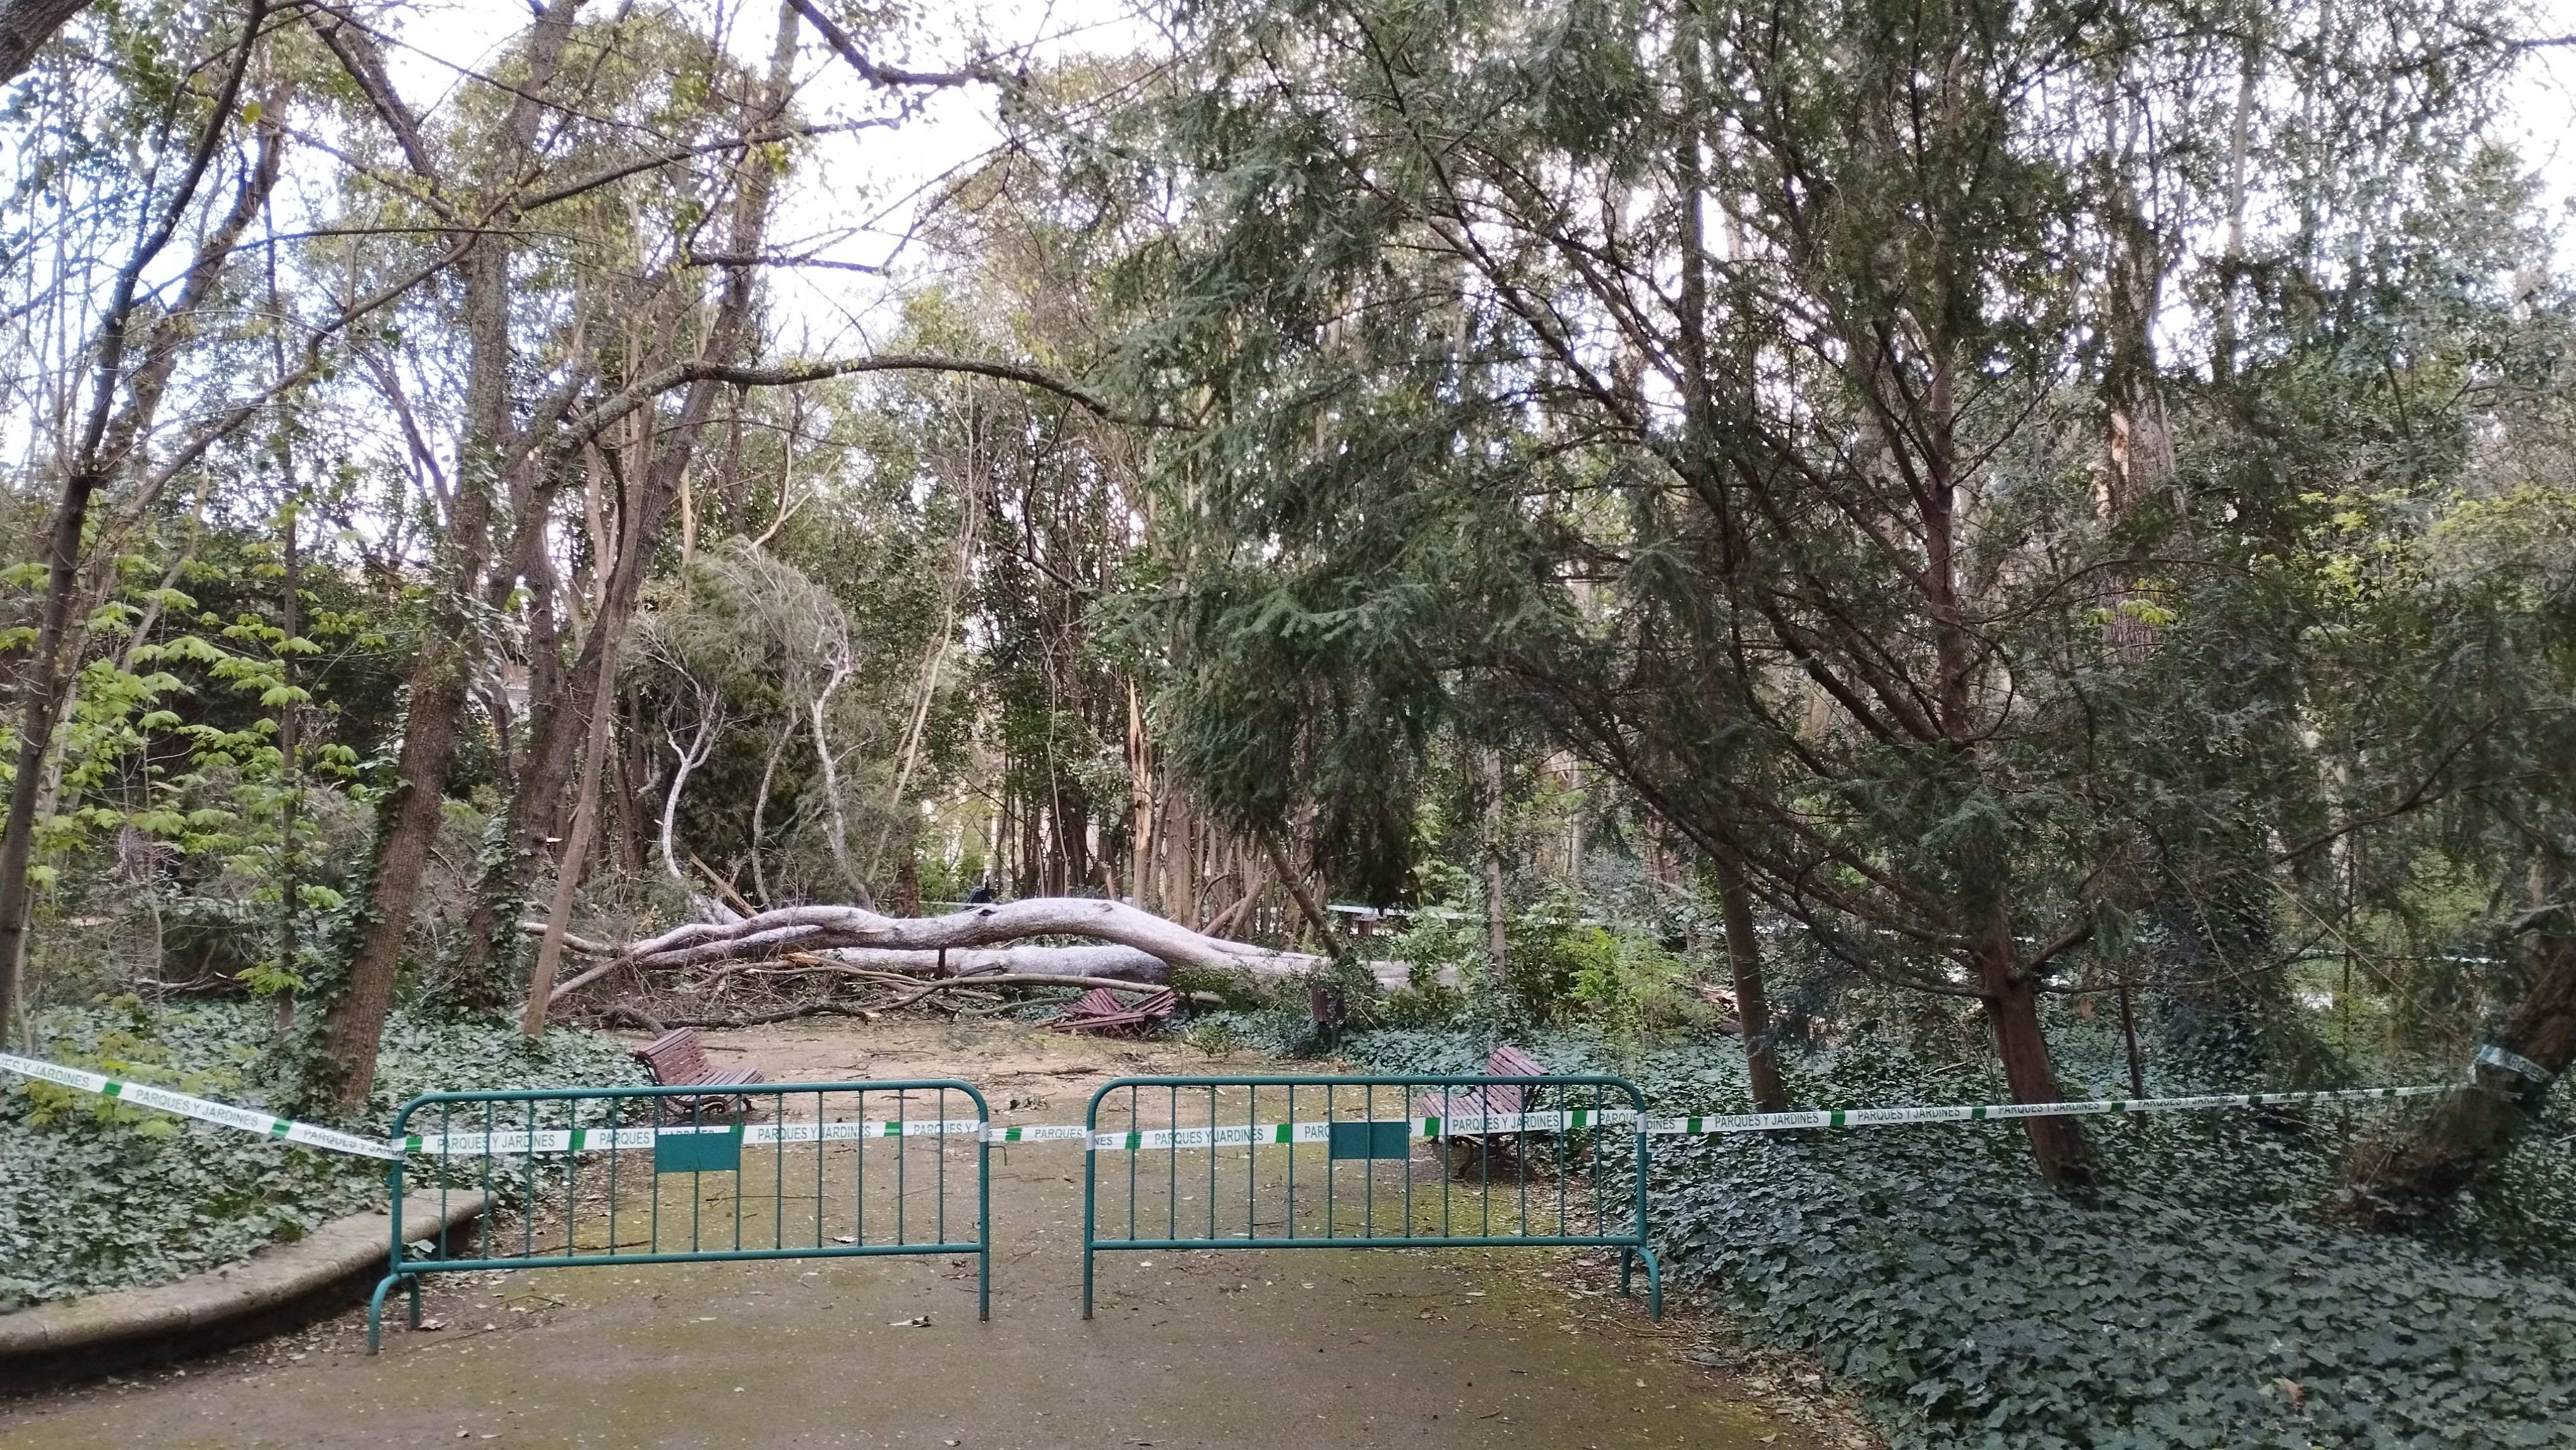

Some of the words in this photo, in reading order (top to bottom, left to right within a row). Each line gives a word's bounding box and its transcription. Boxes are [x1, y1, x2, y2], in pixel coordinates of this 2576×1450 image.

[32, 1065, 90, 1088] JARDINES
[136, 1089, 191, 1111] PARQUES
[193, 1103, 201, 1113] Y
[202, 1105, 258, 1127] JARDINES
[1857, 1109, 1904, 1122] PARQUES
[1904, 1108, 1911, 1119] Y
[1914, 1106, 1961, 1119] JARDINES
[1453, 1117, 1500, 1132] PARQUES
[1501, 1117, 1508, 1129] Y
[1510, 1115, 1559, 1129] JARDINES
[1715, 1115, 1761, 1128] PARQUES
[1763, 1113, 1769, 1125] Y
[1772, 1112, 1820, 1126] JARDINES
[758, 1127, 808, 1141] PARQUES
[810, 1126, 818, 1139] Y
[965, 1123, 972, 1134] Y
[1035, 1129, 1083, 1139] PARQUES
[304, 1128, 358, 1149] PARQUES
[437, 1137, 487, 1150] PARQUES
[492, 1136, 500, 1149] Y
[502, 1135, 556, 1148] JARDNES
[600, 1131, 650, 1145] PARQUES
[1155, 1131, 1202, 1145] PARQUES
[1205, 1132, 1212, 1144] Y
[1212, 1129, 1263, 1144] JARDINES
